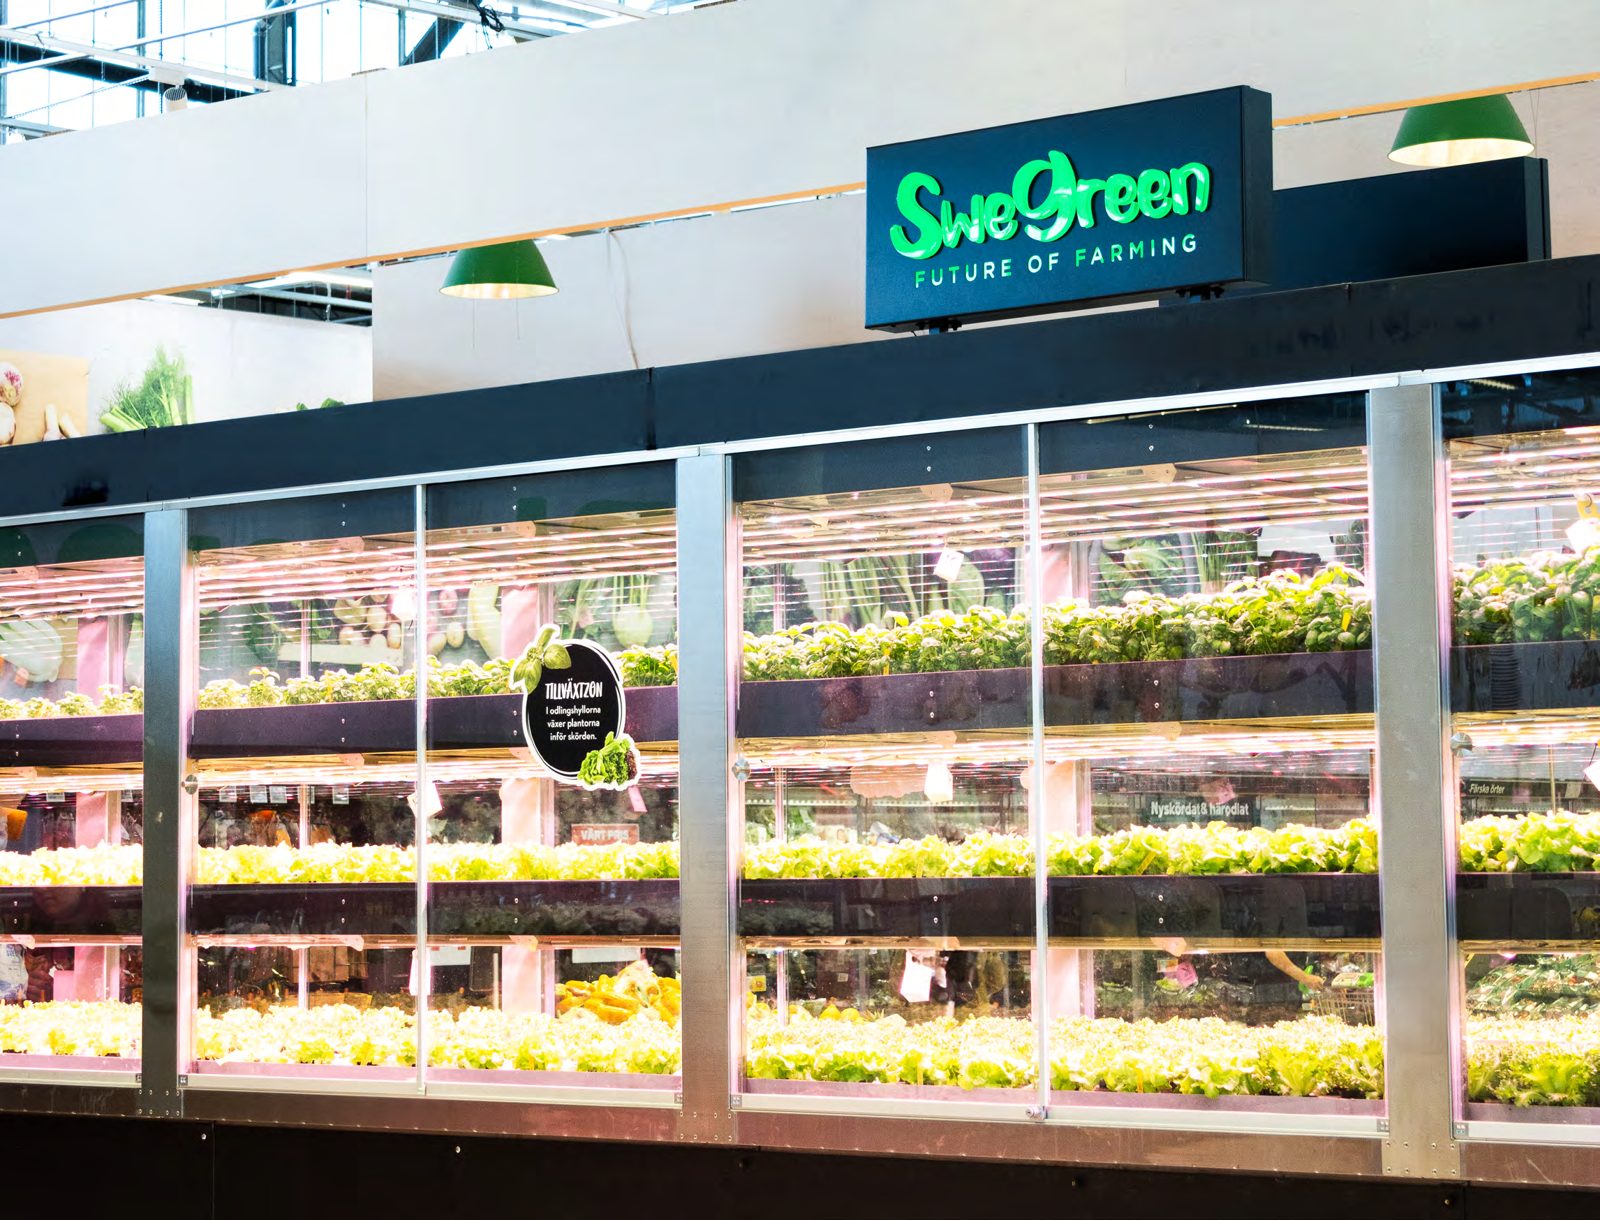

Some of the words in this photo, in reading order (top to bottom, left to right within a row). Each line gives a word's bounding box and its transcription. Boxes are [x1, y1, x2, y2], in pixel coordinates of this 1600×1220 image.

[915, 259, 1013, 289] FUTURE
[1028, 252, 1060, 273] OF
[1075, 234, 1197, 267] FARMING
[545, 678, 603, 699] TILLVÄXTZON
[545, 706, 549, 714] I
[549, 705, 601, 716] odlingshyllorna
[547, 720, 566, 728] växer
[567, 718, 600, 730] plantorna
[550, 731, 567, 741] inför
[568, 731, 597, 740] skörden.
[1200, 803, 1208, 815] &
